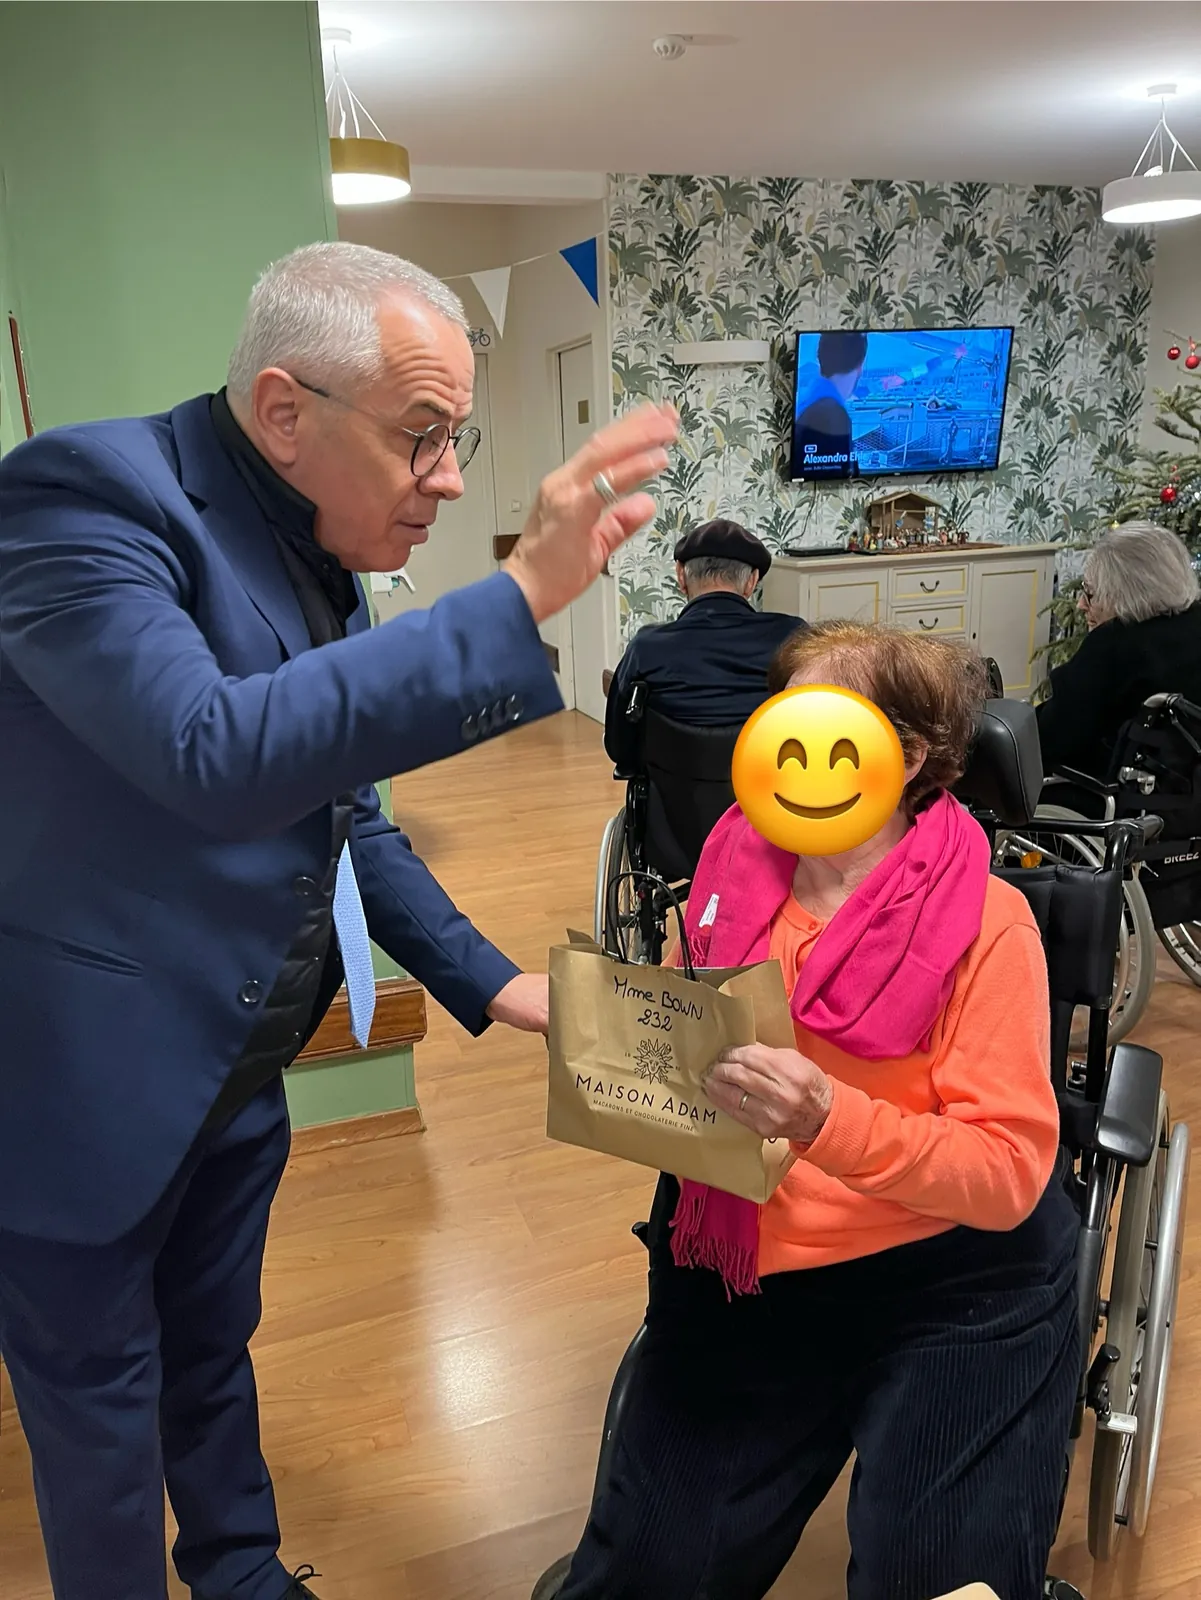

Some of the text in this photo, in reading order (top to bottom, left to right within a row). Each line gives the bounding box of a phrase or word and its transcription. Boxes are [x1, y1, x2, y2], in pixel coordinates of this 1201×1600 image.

[803, 452, 848, 464] Alexandra
[614, 975, 703, 1020] Mme BOWN
[637, 1008, 672, 1032] 232
[576, 1073, 717, 1125] MAISON ADAM
[593, 1099, 624, 1112] MACARONS
[634, 1110, 678, 1127] CHOCOLATERIE
[679, 1123, 694, 1132] FINE
